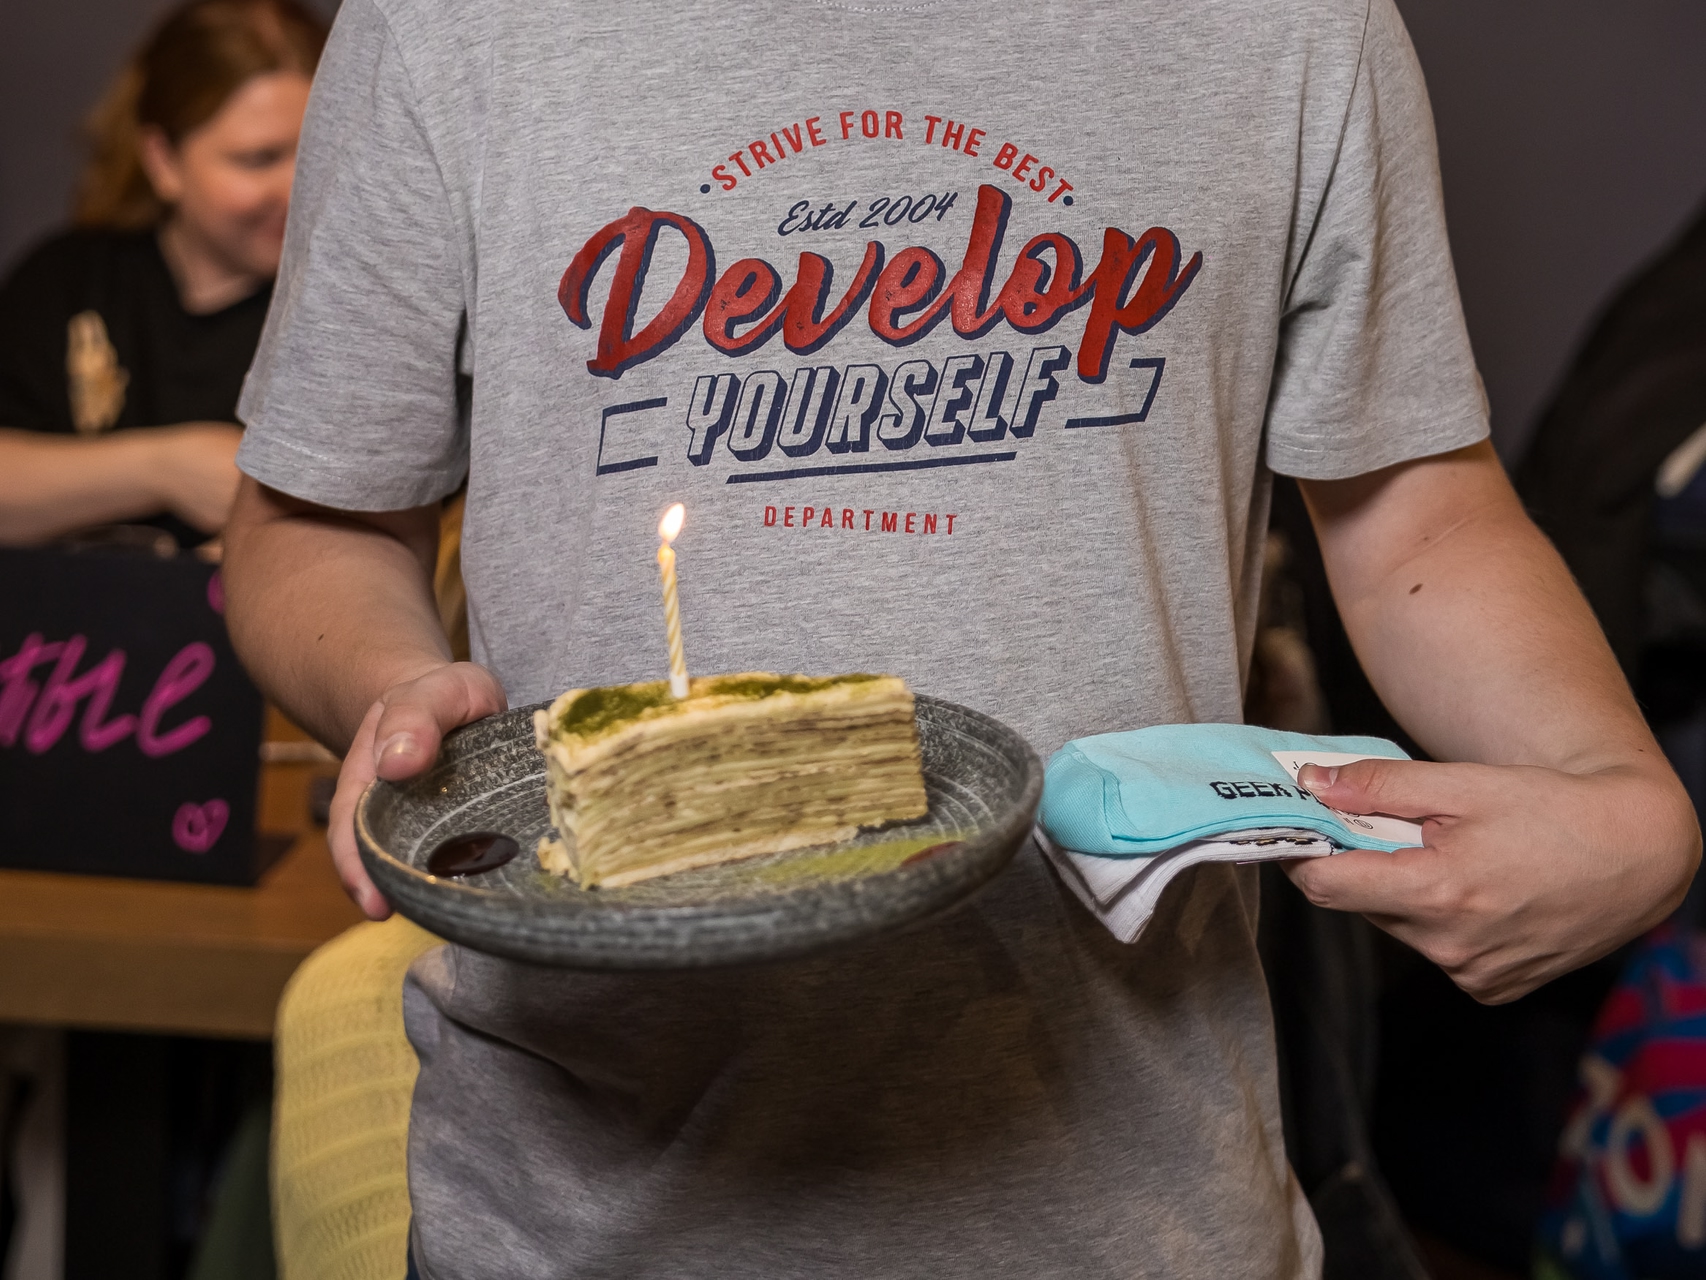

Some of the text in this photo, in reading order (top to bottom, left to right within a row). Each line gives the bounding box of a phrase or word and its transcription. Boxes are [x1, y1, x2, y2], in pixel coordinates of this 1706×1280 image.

[712, 110, 1074, 203] STRIVE FOR THE BEST
[777, 192, 958, 237] Estd 2004
[557, 184, 1202, 384] Develop
[686, 344, 1073, 467] YOURSELF
[764, 505, 957, 535] DEPARTMENT
[1209, 780, 1293, 801] GEEK
